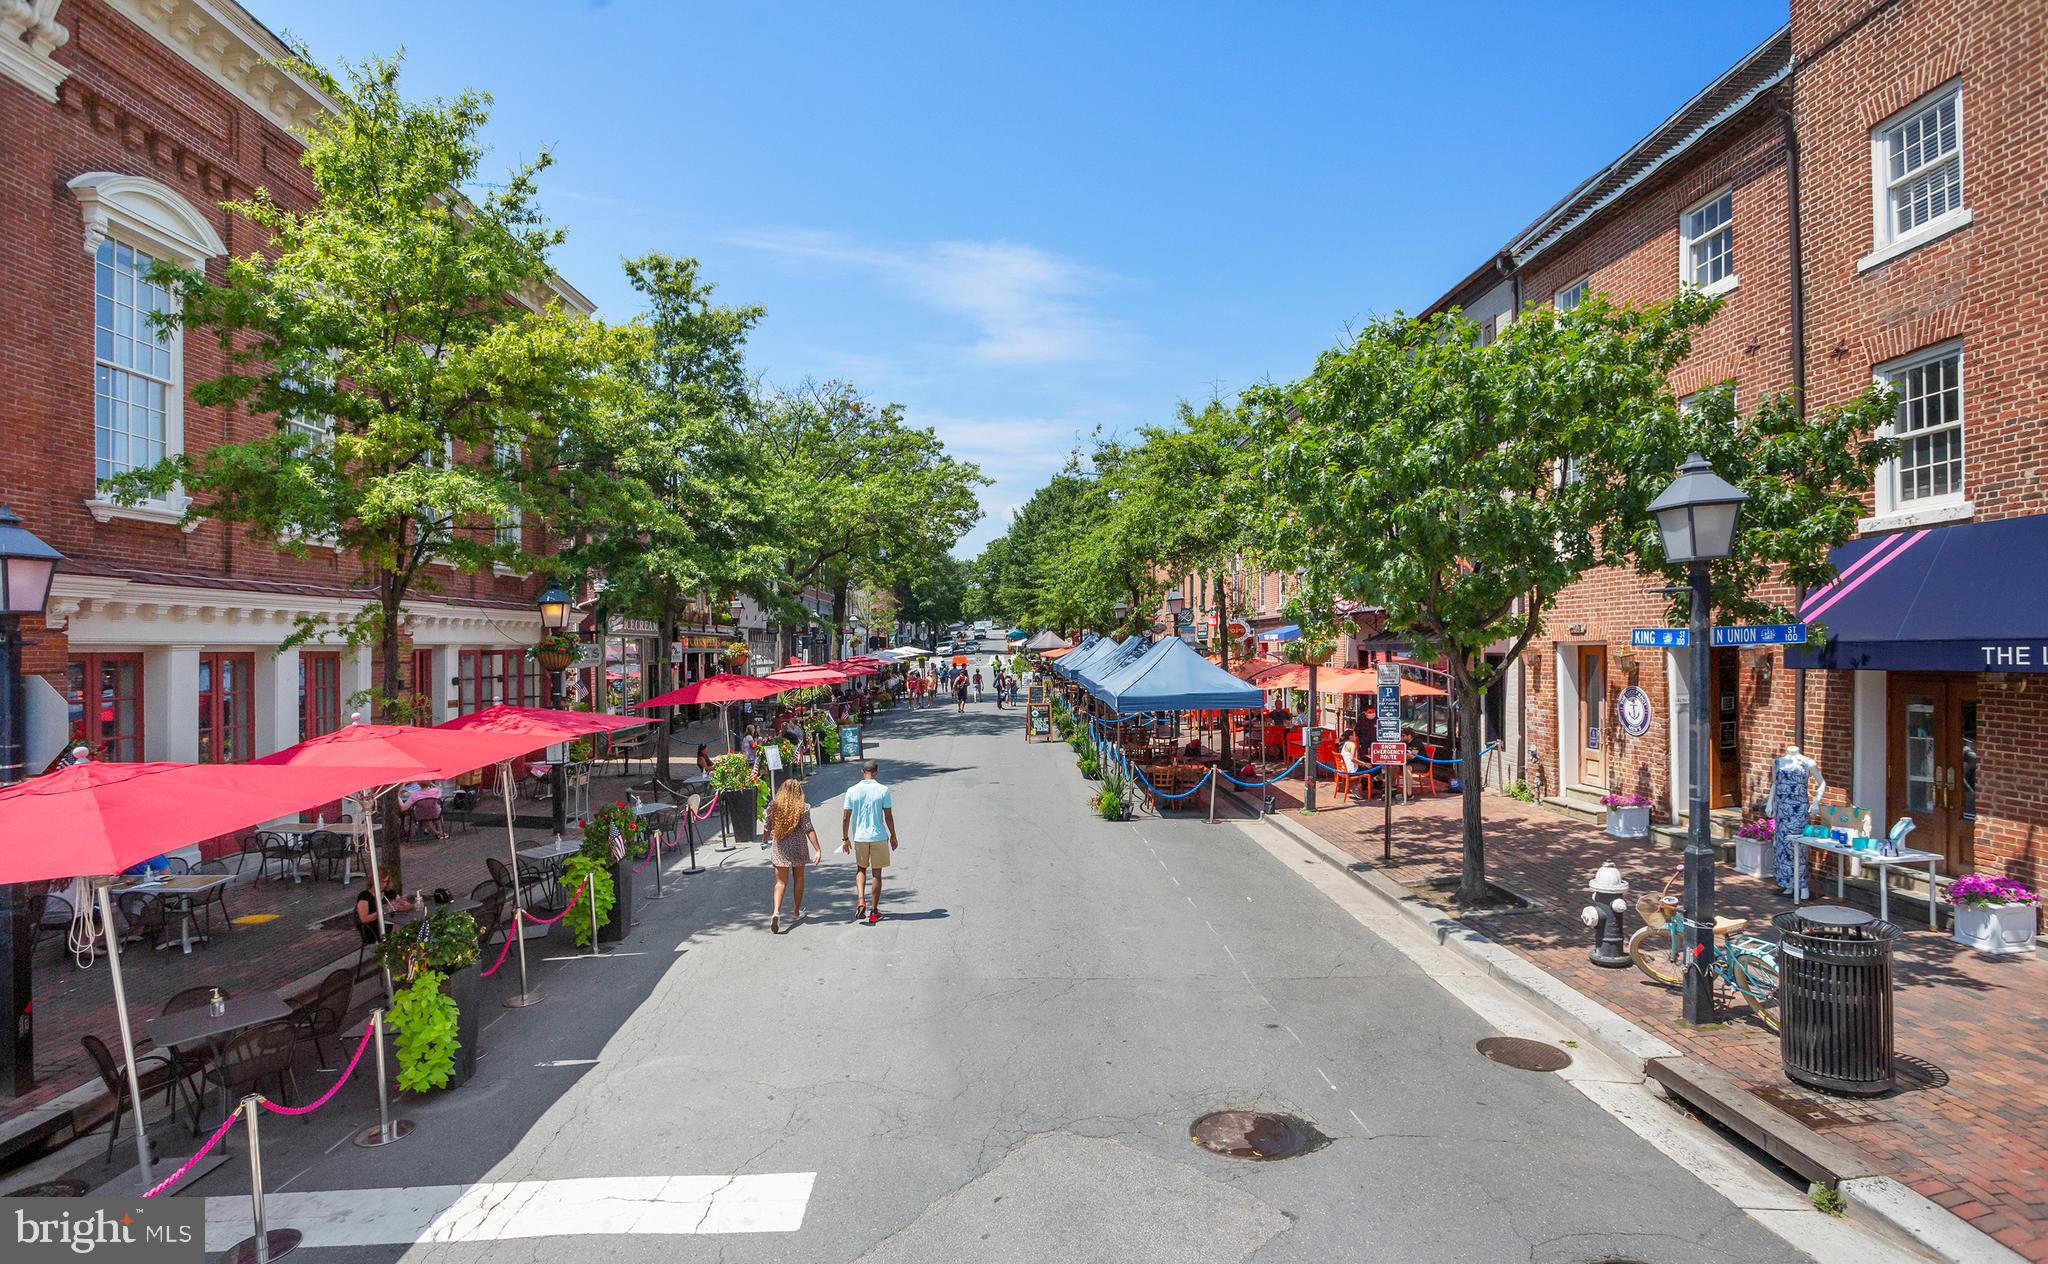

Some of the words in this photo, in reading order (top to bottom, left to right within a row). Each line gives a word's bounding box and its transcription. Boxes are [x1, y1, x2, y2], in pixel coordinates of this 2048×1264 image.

[1787, 626, 1798, 634] ST
[1634, 630, 1656, 644] KING
[1717, 629, 1724, 643] N
[1728, 628, 1757, 643] UNION
[1784, 633, 1798, 641] 100
[1676, 638, 1686, 646] 100
[1982, 646, 2031, 665] THE
[1385, 687, 1393, 697] P
